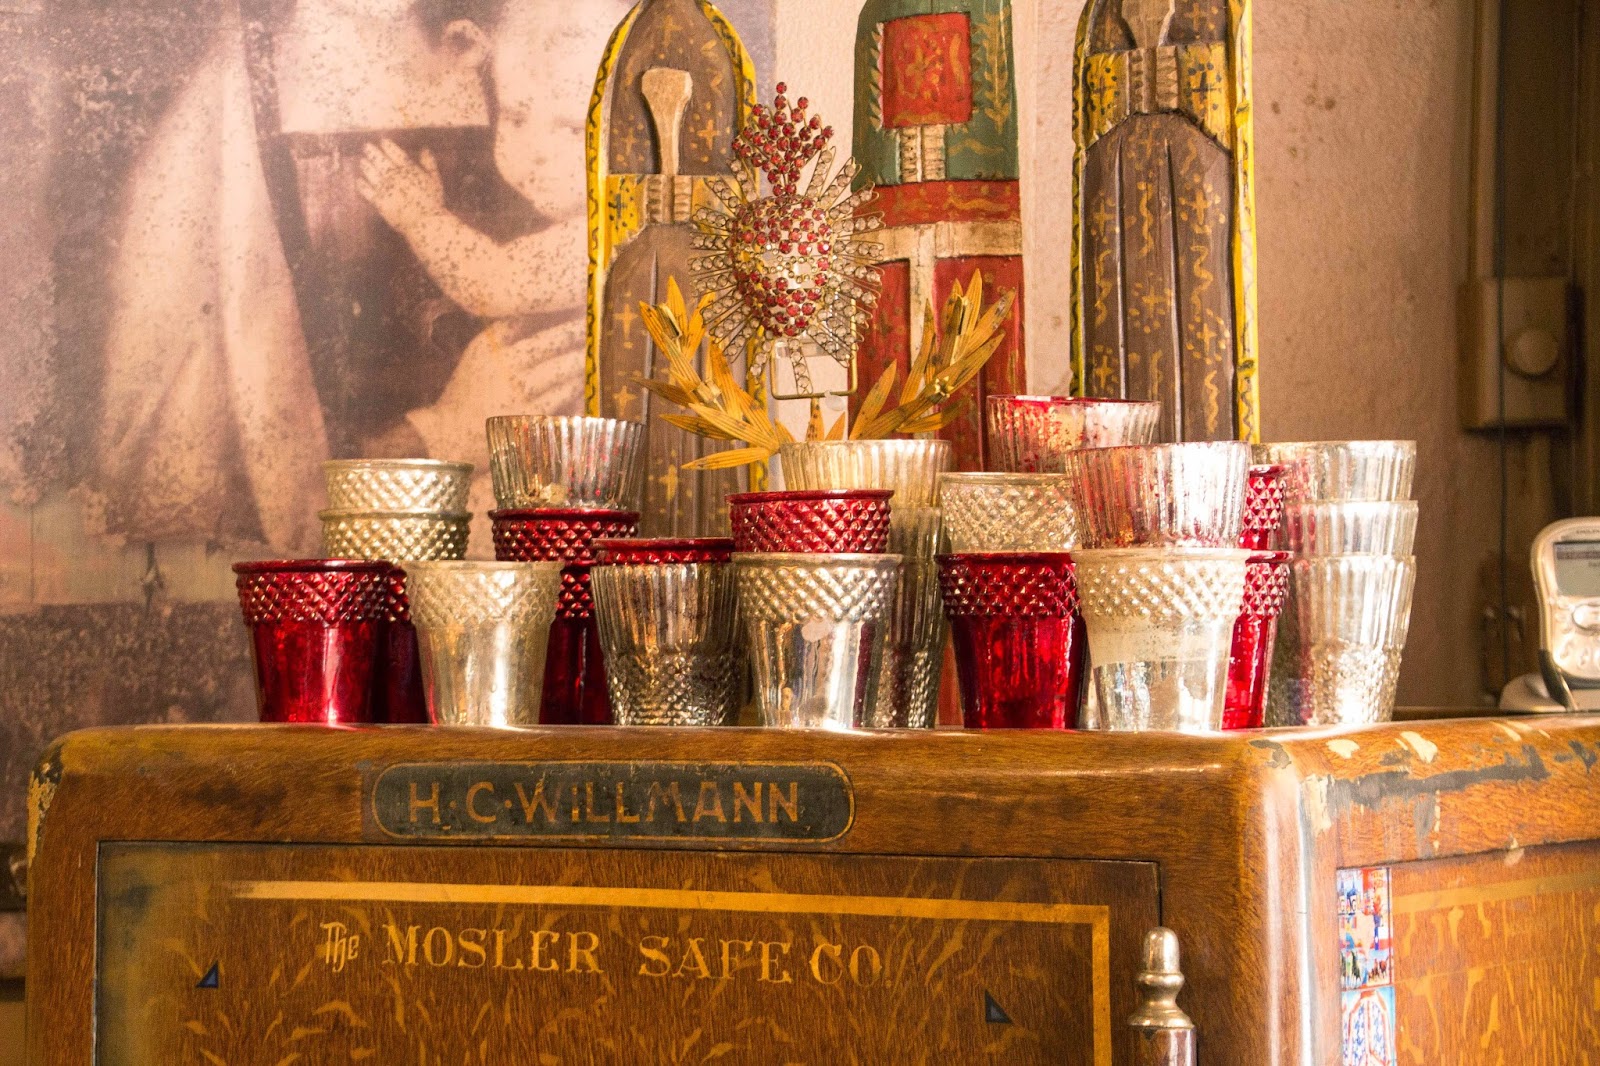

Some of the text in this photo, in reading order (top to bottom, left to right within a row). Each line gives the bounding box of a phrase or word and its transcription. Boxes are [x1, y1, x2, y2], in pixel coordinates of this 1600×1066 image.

[320, 921, 360, 973] The
[381, 924, 604, 974] MOSLER
[638, 934, 792, 984] SAFE
